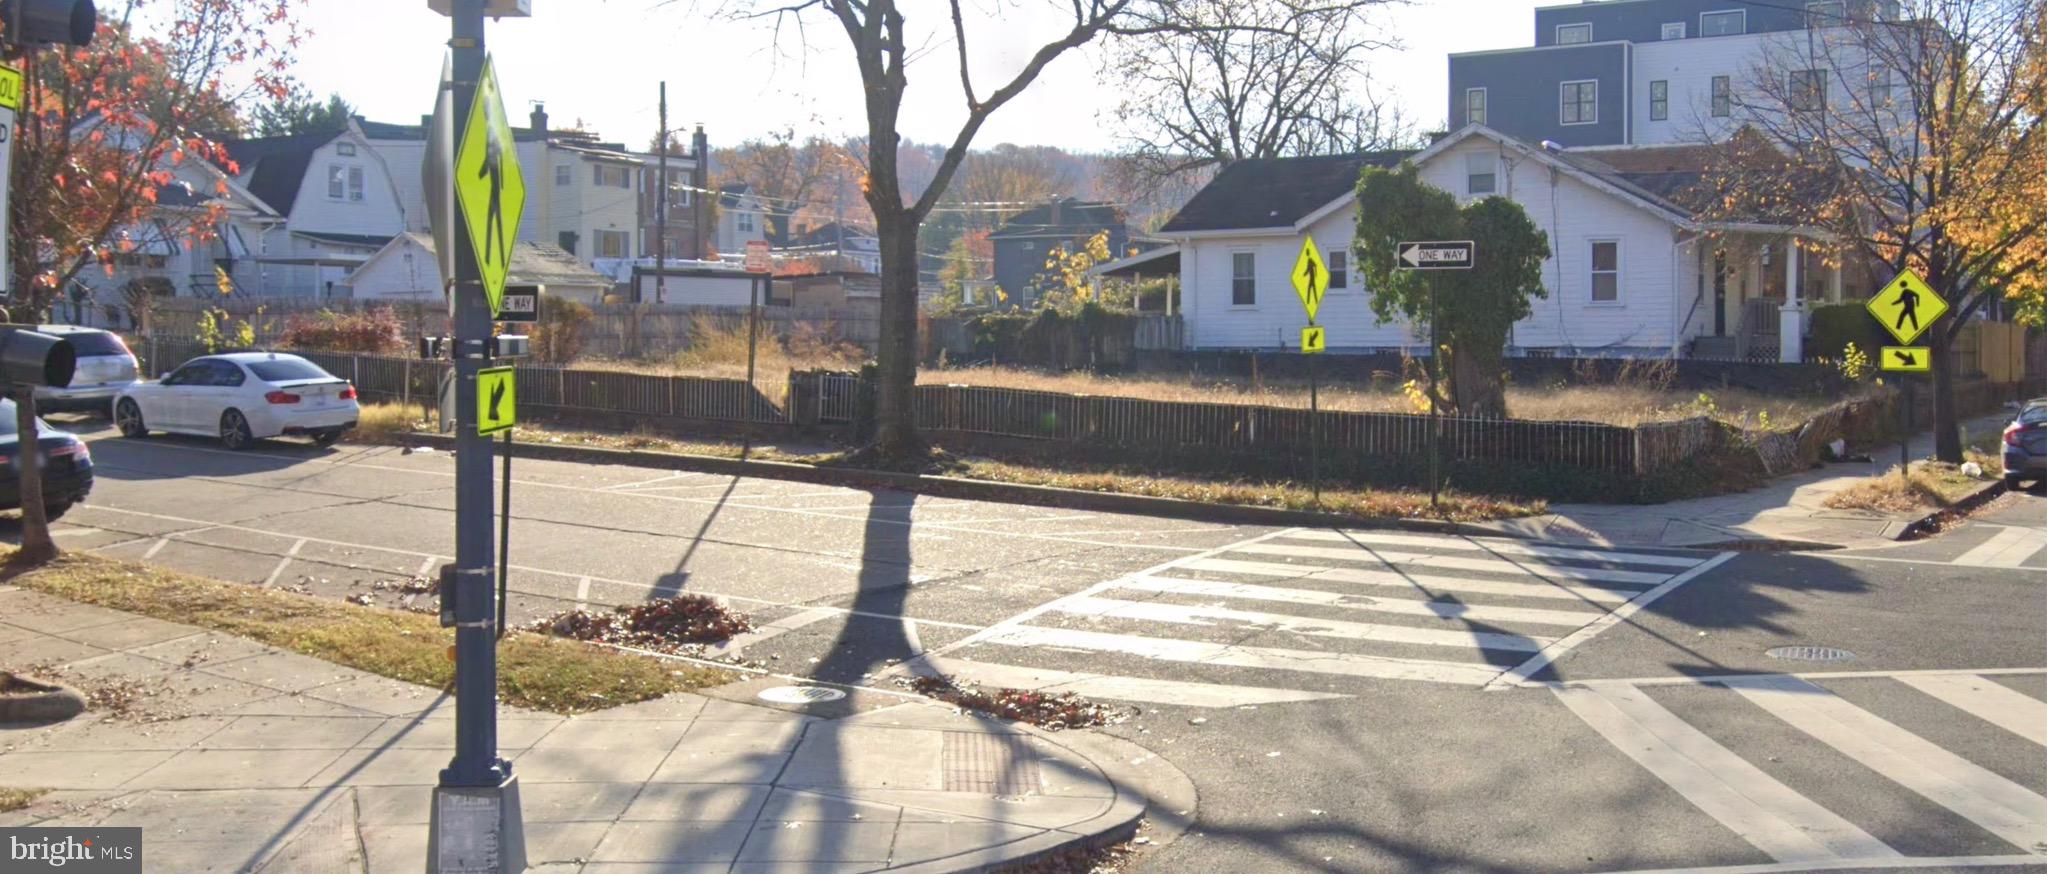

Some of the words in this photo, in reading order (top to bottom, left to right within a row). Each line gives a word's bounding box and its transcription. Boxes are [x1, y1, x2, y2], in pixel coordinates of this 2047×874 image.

[1418, 250, 1439, 260] ONE
[1443, 250, 1464, 260] WAY
[513, 296, 532, 310] WAY
